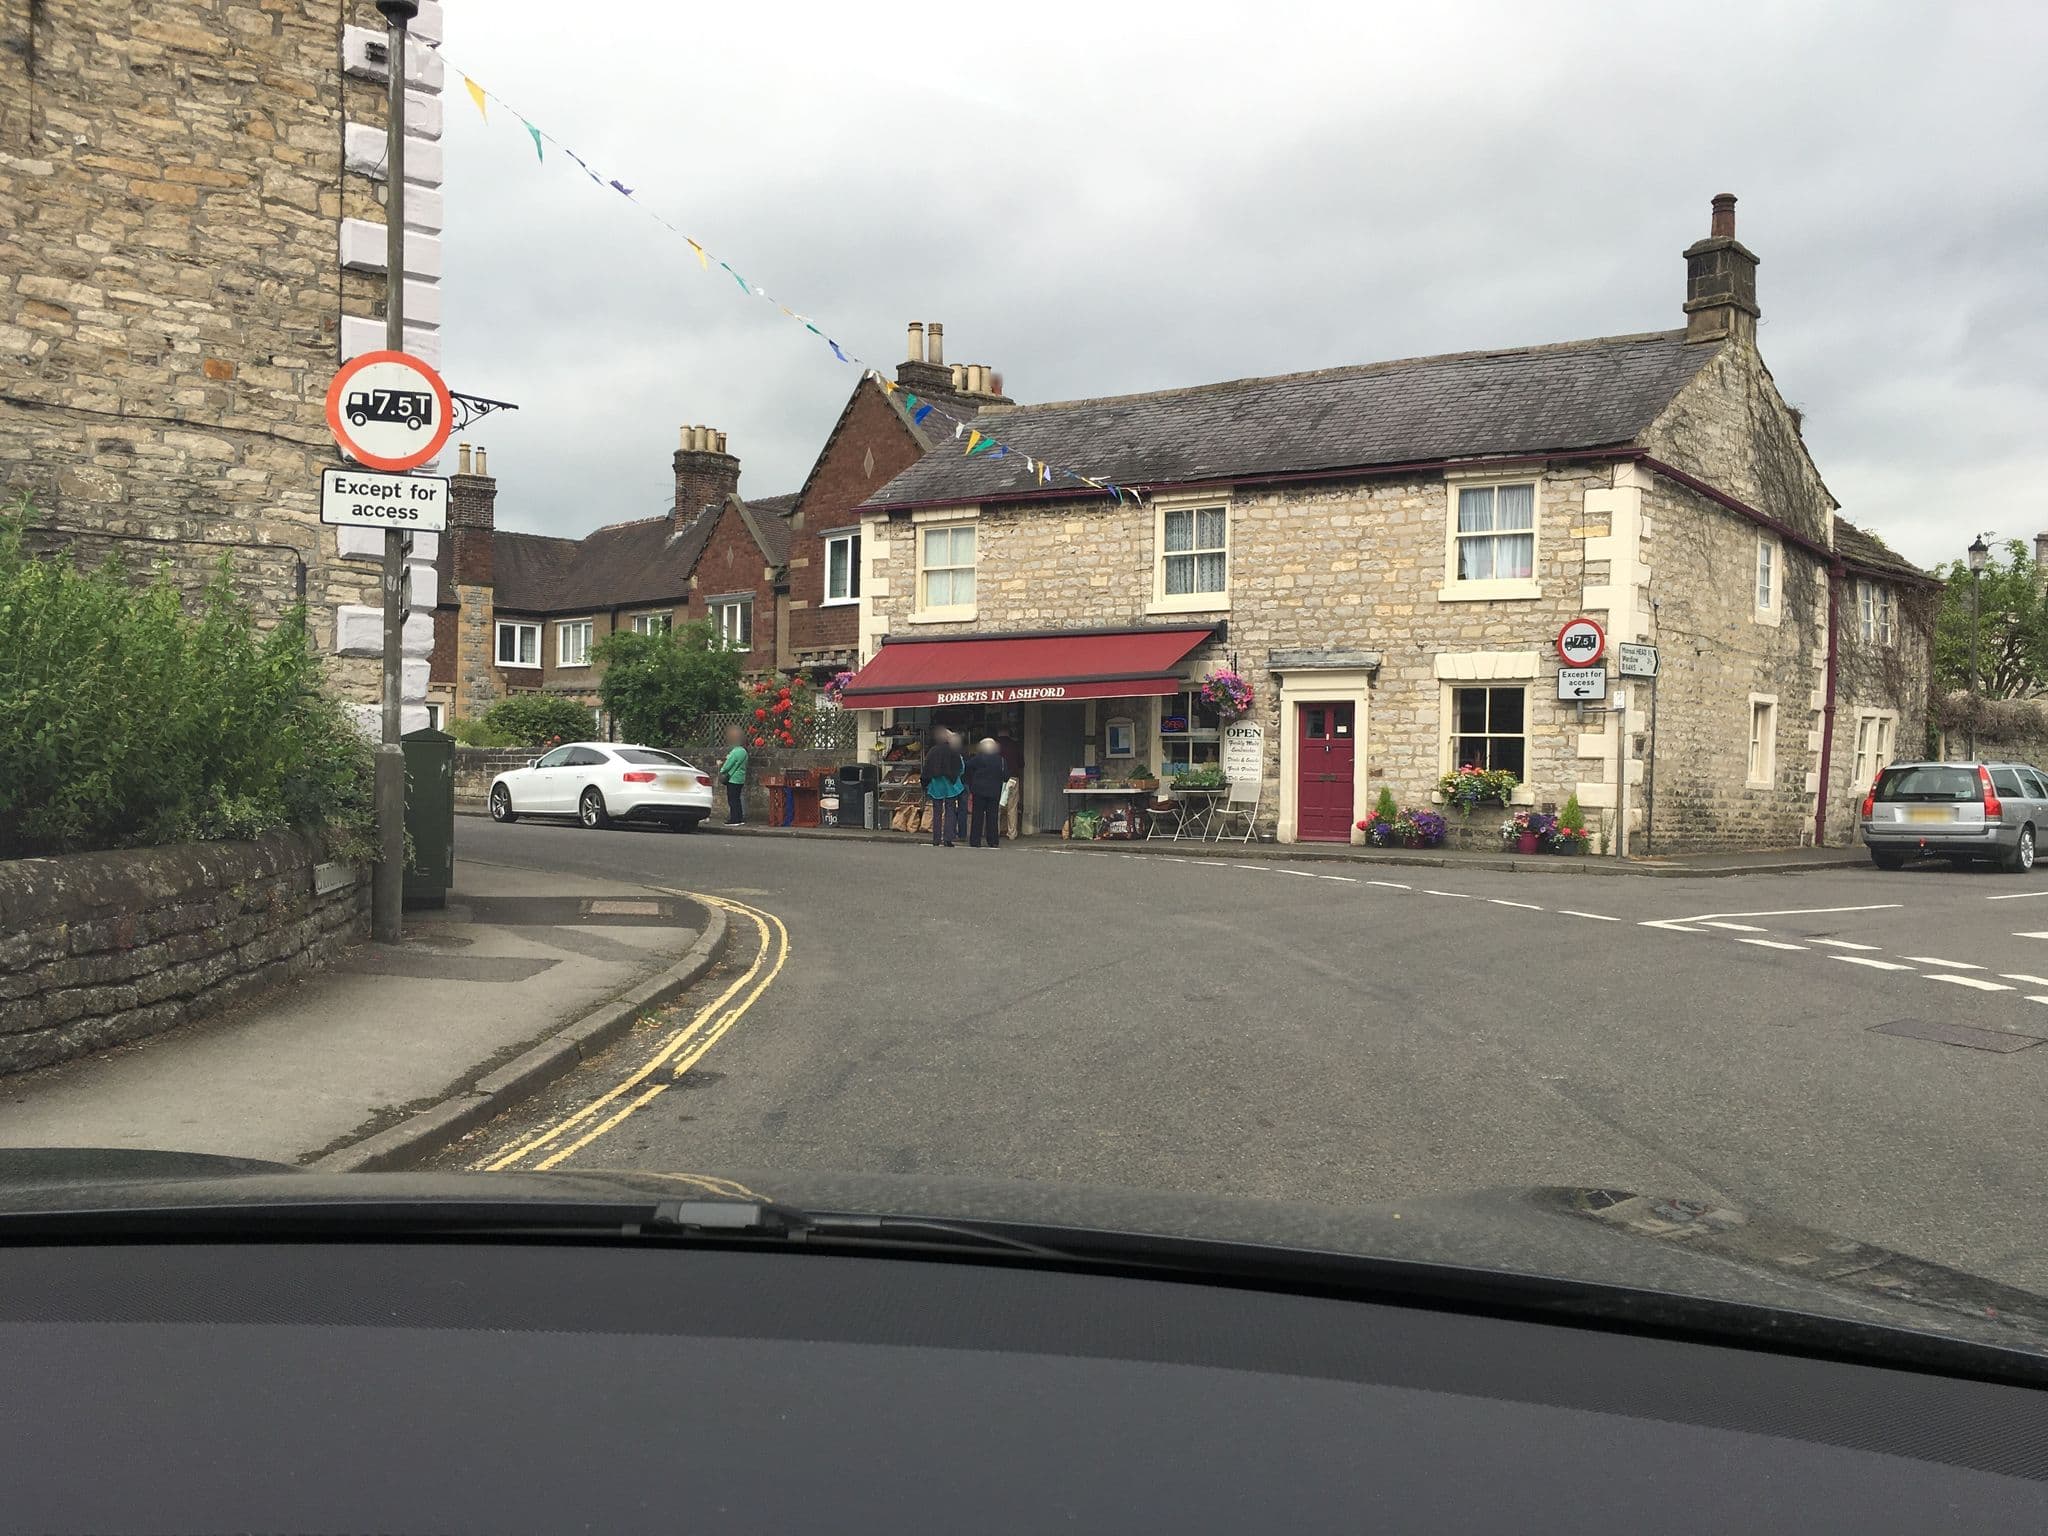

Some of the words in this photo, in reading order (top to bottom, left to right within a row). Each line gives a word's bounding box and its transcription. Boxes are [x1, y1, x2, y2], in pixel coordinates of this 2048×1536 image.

[374, 391, 430, 417] 7.5T
[334, 478, 402, 500] Except
[410, 484, 437, 501] for
[352, 503, 419, 520] access
[937, 691, 988, 704] ROBERTS
[991, 690, 1004, 700] IN
[1008, 688, 1065, 700] ASHFORD
[1226, 728, 1262, 738] OPEN
